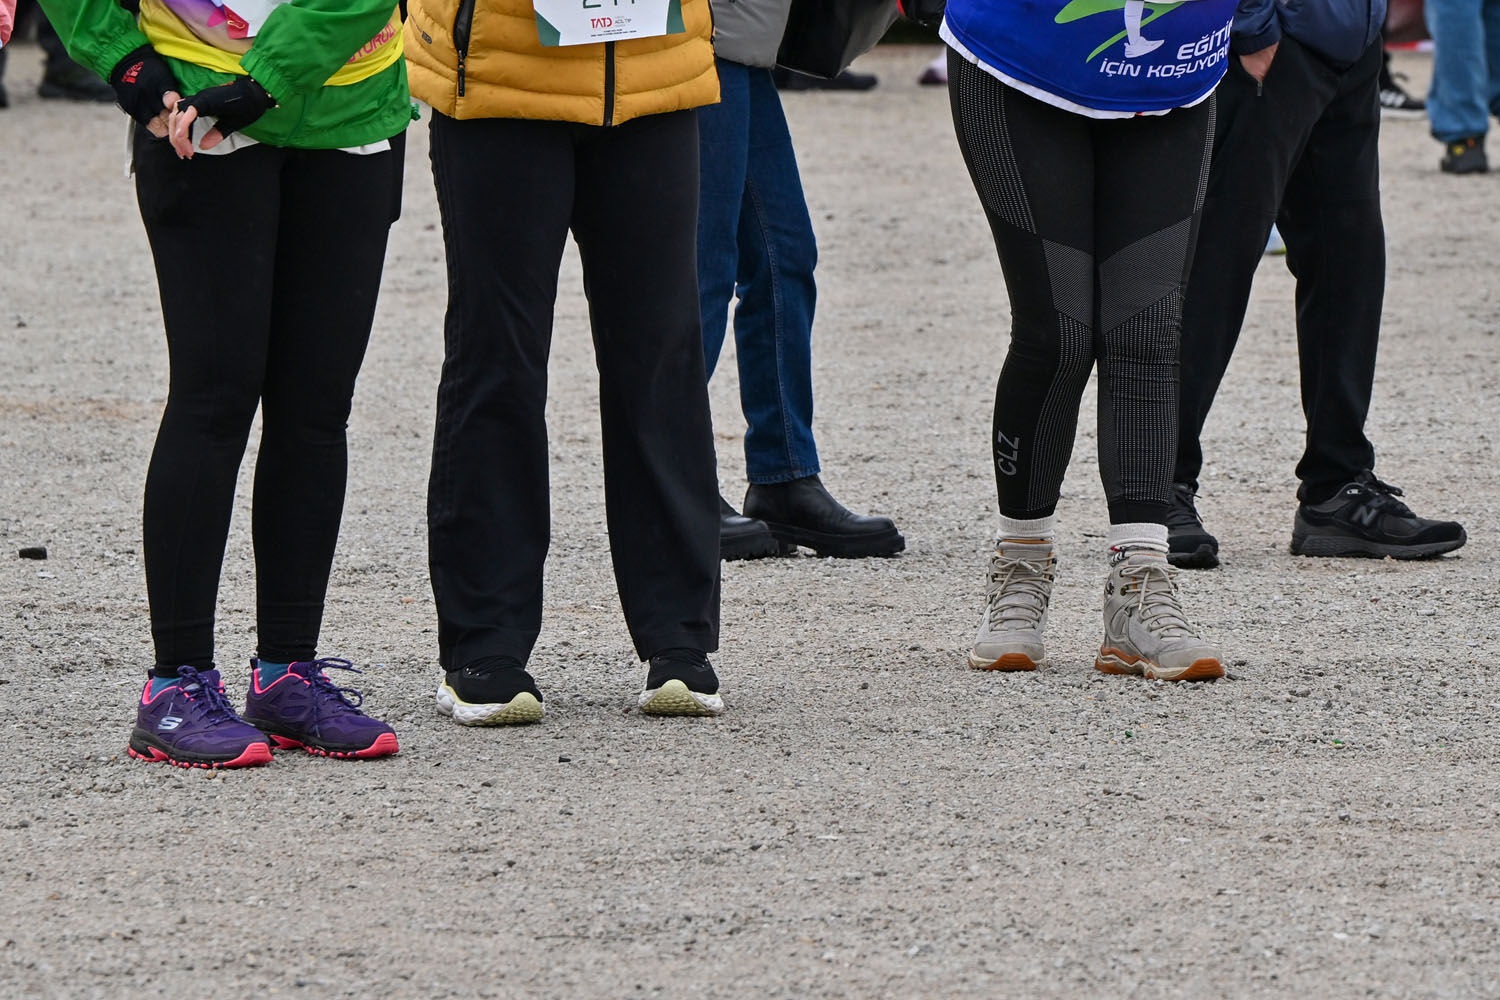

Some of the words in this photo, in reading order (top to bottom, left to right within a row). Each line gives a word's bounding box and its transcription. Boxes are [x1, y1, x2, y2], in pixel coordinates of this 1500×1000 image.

[590, 16, 613, 29] TATD
[1099, 58, 1141, 78] İÇİN
[997, 430, 1020, 476] CLZ
